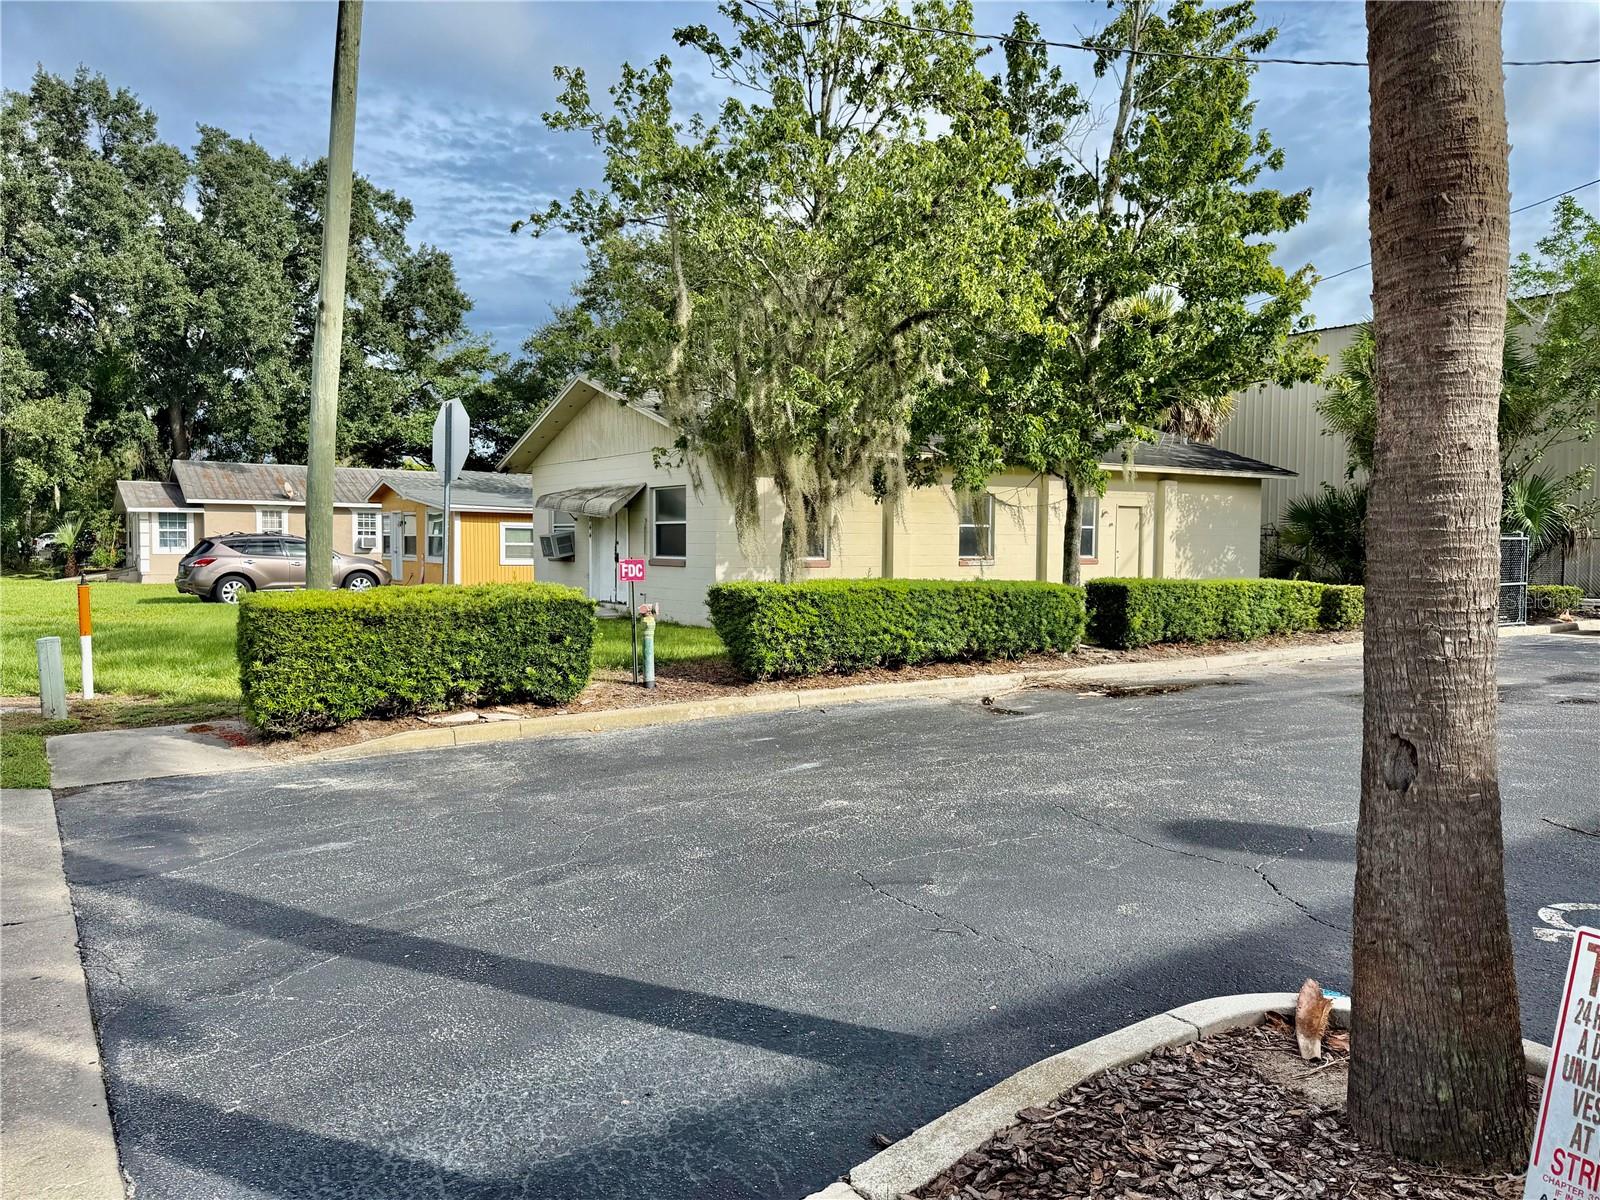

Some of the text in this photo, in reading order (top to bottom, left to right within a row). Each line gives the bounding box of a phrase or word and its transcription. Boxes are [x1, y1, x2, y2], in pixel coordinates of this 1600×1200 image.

[622, 564, 643, 578] FDC
[1574, 997, 1593, 1027] 24
[1577, 1028, 1589, 1056] A
[1562, 1054, 1600, 1094] UNA
[1569, 1122, 1596, 1154] AT
[1542, 1174, 1585, 1199] CHAPTER
